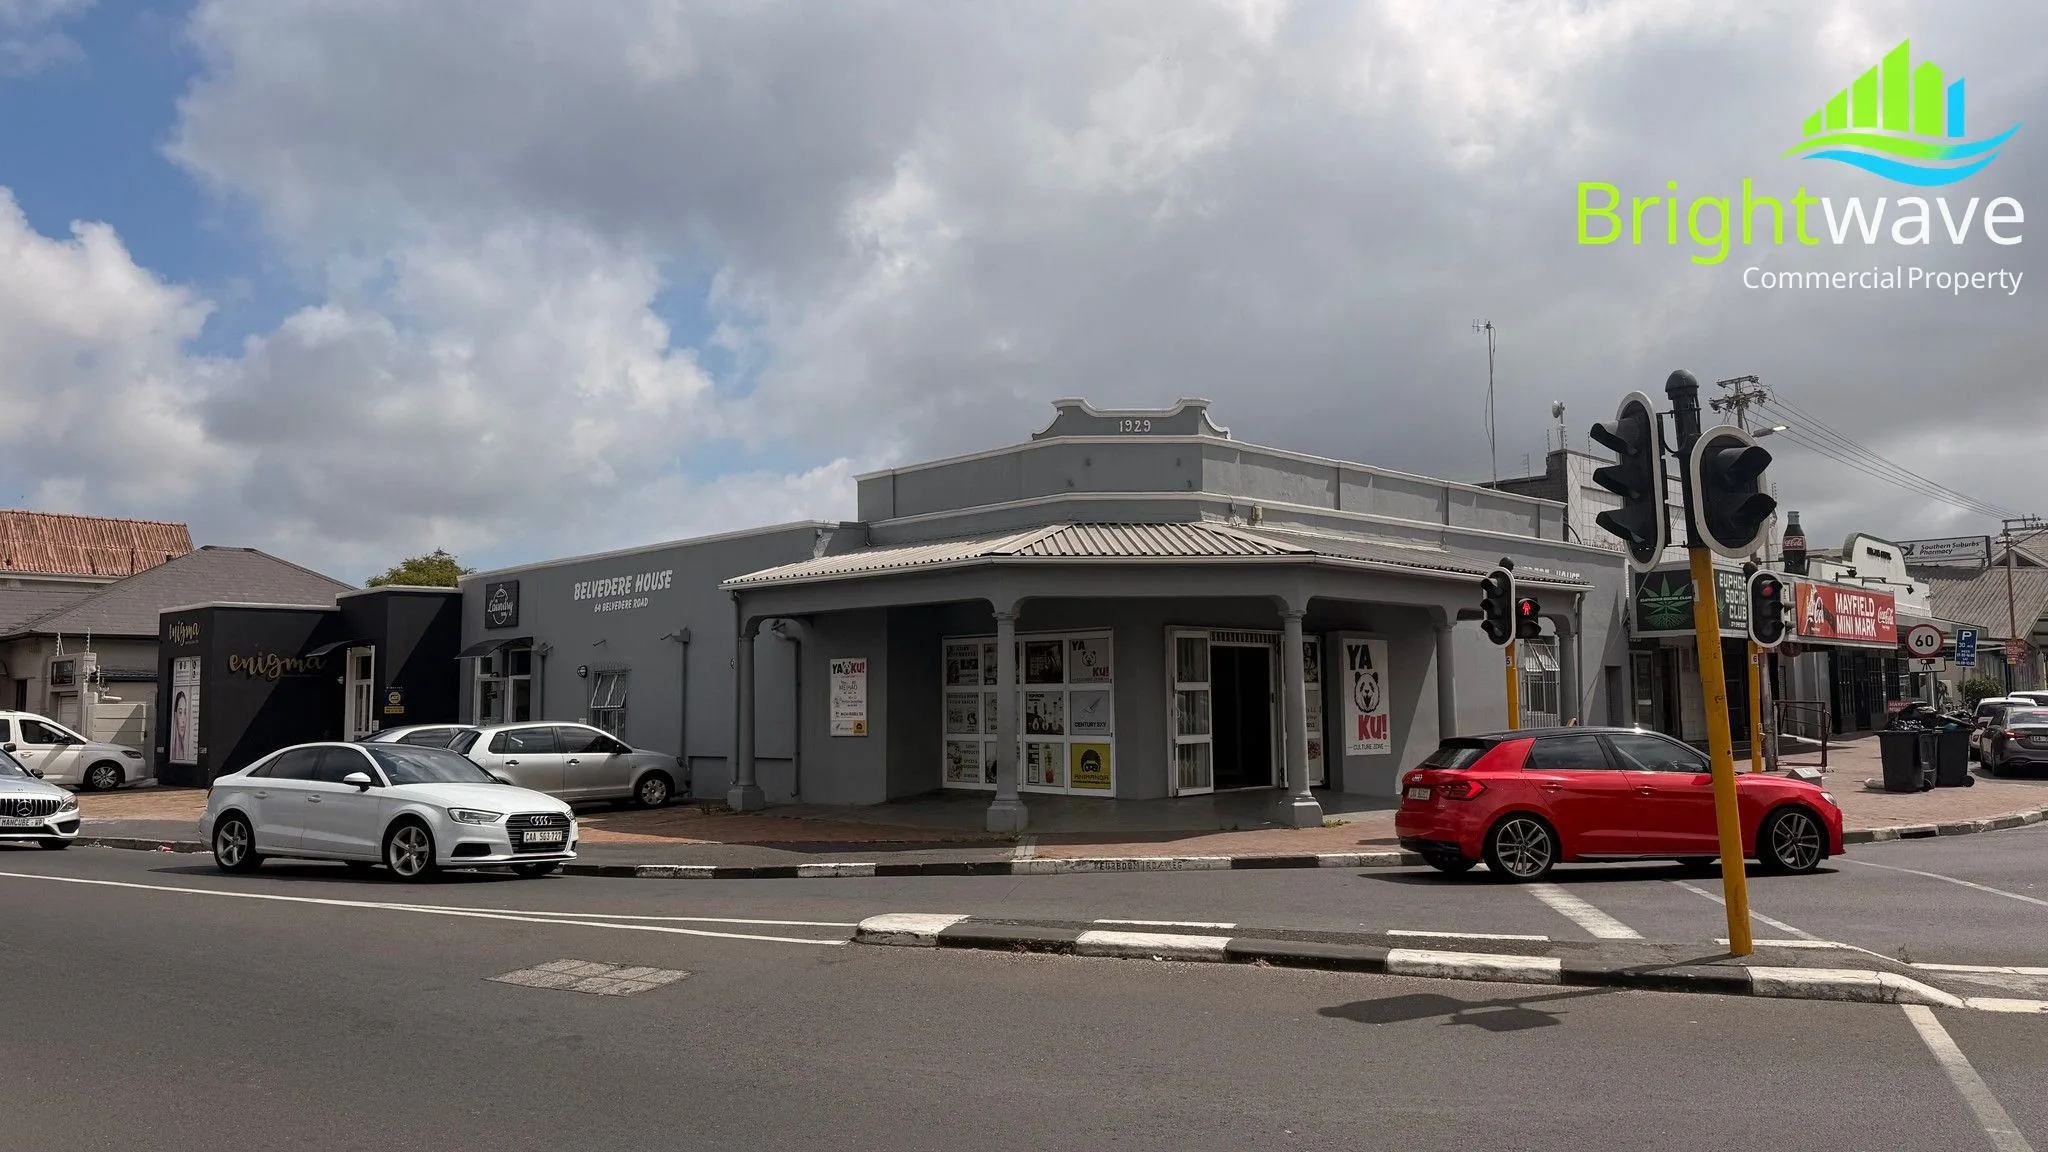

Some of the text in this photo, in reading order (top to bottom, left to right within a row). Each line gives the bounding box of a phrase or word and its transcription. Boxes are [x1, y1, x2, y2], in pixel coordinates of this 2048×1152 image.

[1119, 419, 1151, 432] 1929
[574, 570, 673, 601] BELVEDERE HOUSE
[602, 599, 632, 612] BELVEDERE
[633, 597, 649, 609] ROAD
[1729, 604, 1748, 620] CLUB
[1835, 592, 1875, 617] MAYFIELD
[1836, 615, 1877, 637] MINI MARK
[1915, 635, 1934, 647] 60
[1962, 631, 1972, 640] P
[1071, 641, 1085, 651] YA
[229, 650, 327, 679] enigma
[1346, 644, 1373, 670] YA
[1092, 667, 1110, 678] KU!
[1358, 714, 1387, 741] KU!
